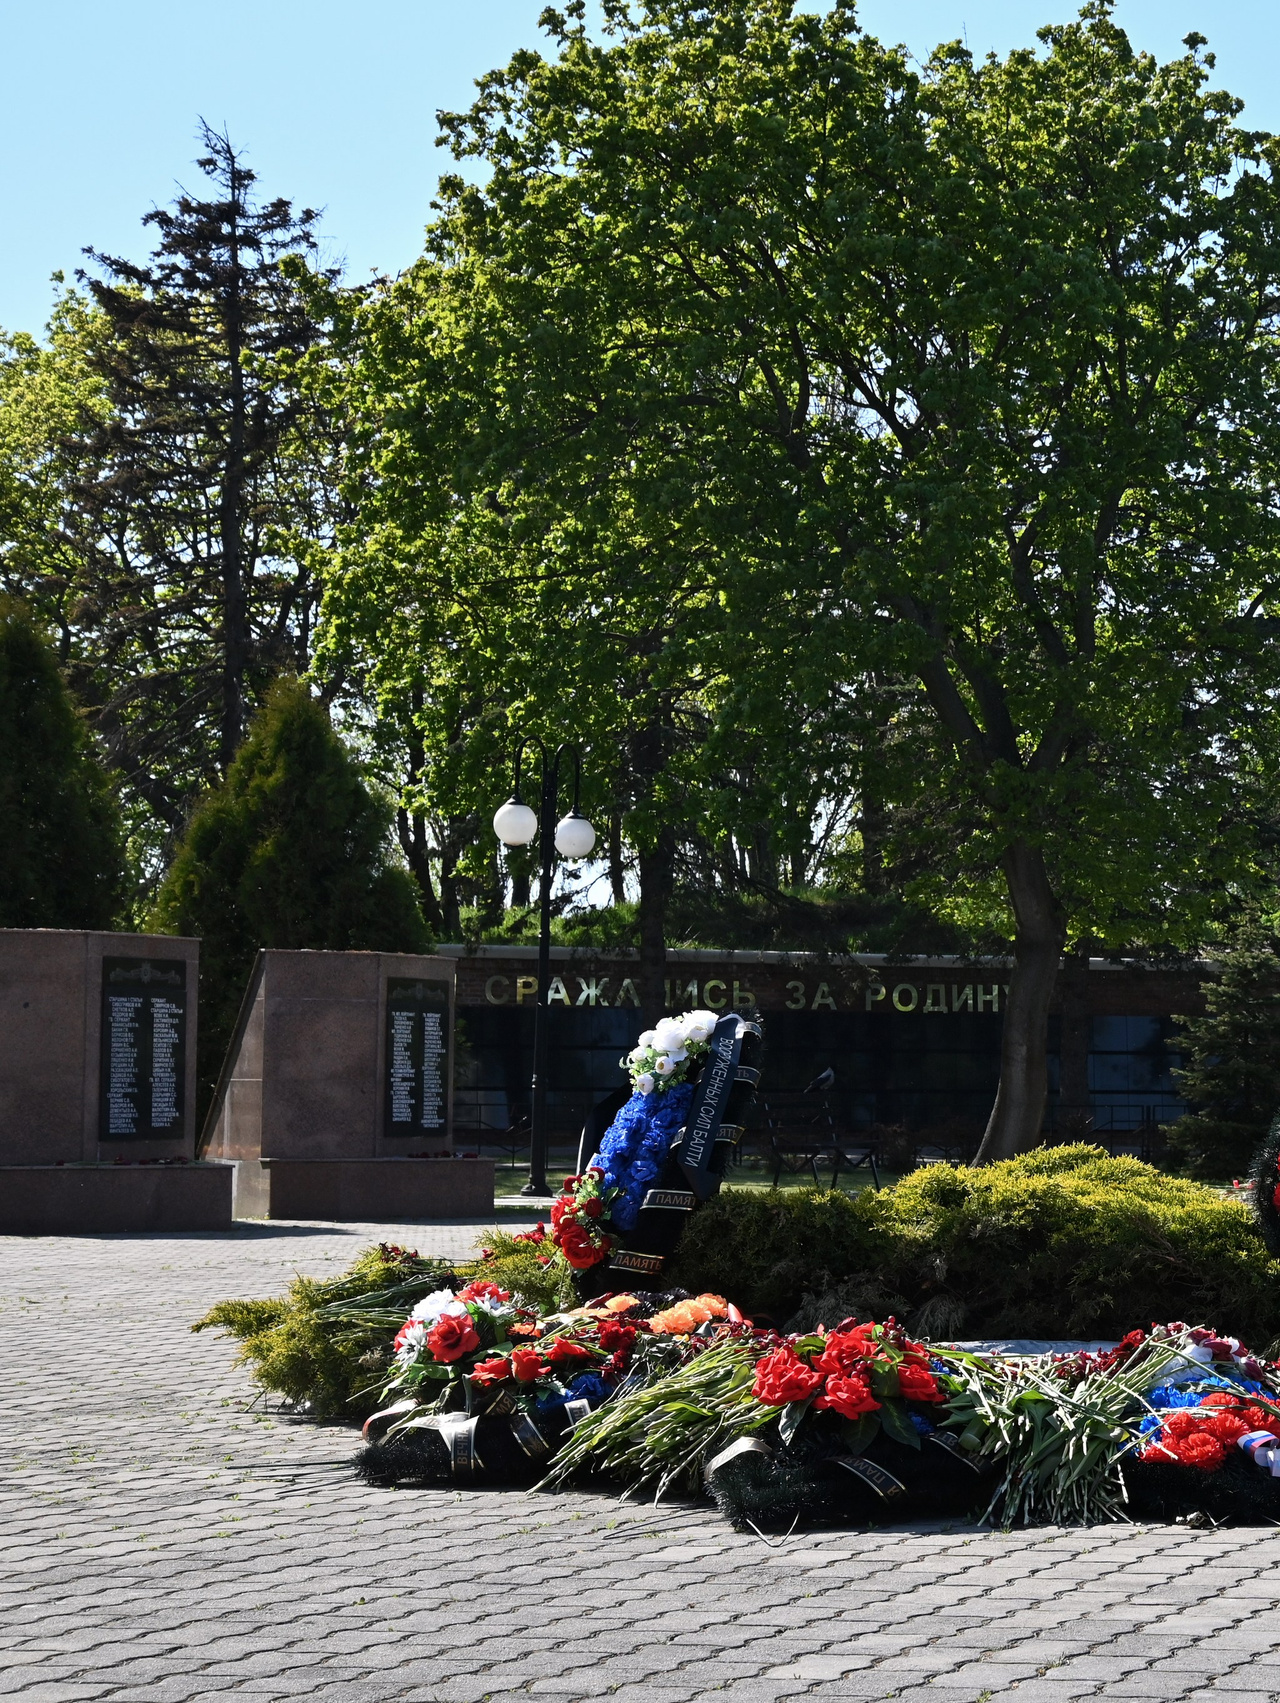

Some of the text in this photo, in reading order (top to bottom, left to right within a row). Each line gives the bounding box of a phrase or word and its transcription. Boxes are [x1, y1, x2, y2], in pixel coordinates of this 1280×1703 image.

[484, 975, 1010, 1014] СРАЖАИСЬ ЗА РОДИН
[703, 1037, 734, 1107] ВООРУЖЕННЫХ
[697, 1106, 715, 1129] СИЛ
[656, 1194, 696, 1206] ПАМЯТ
[614, 1255, 662, 1270] ПАМЯТЬ
